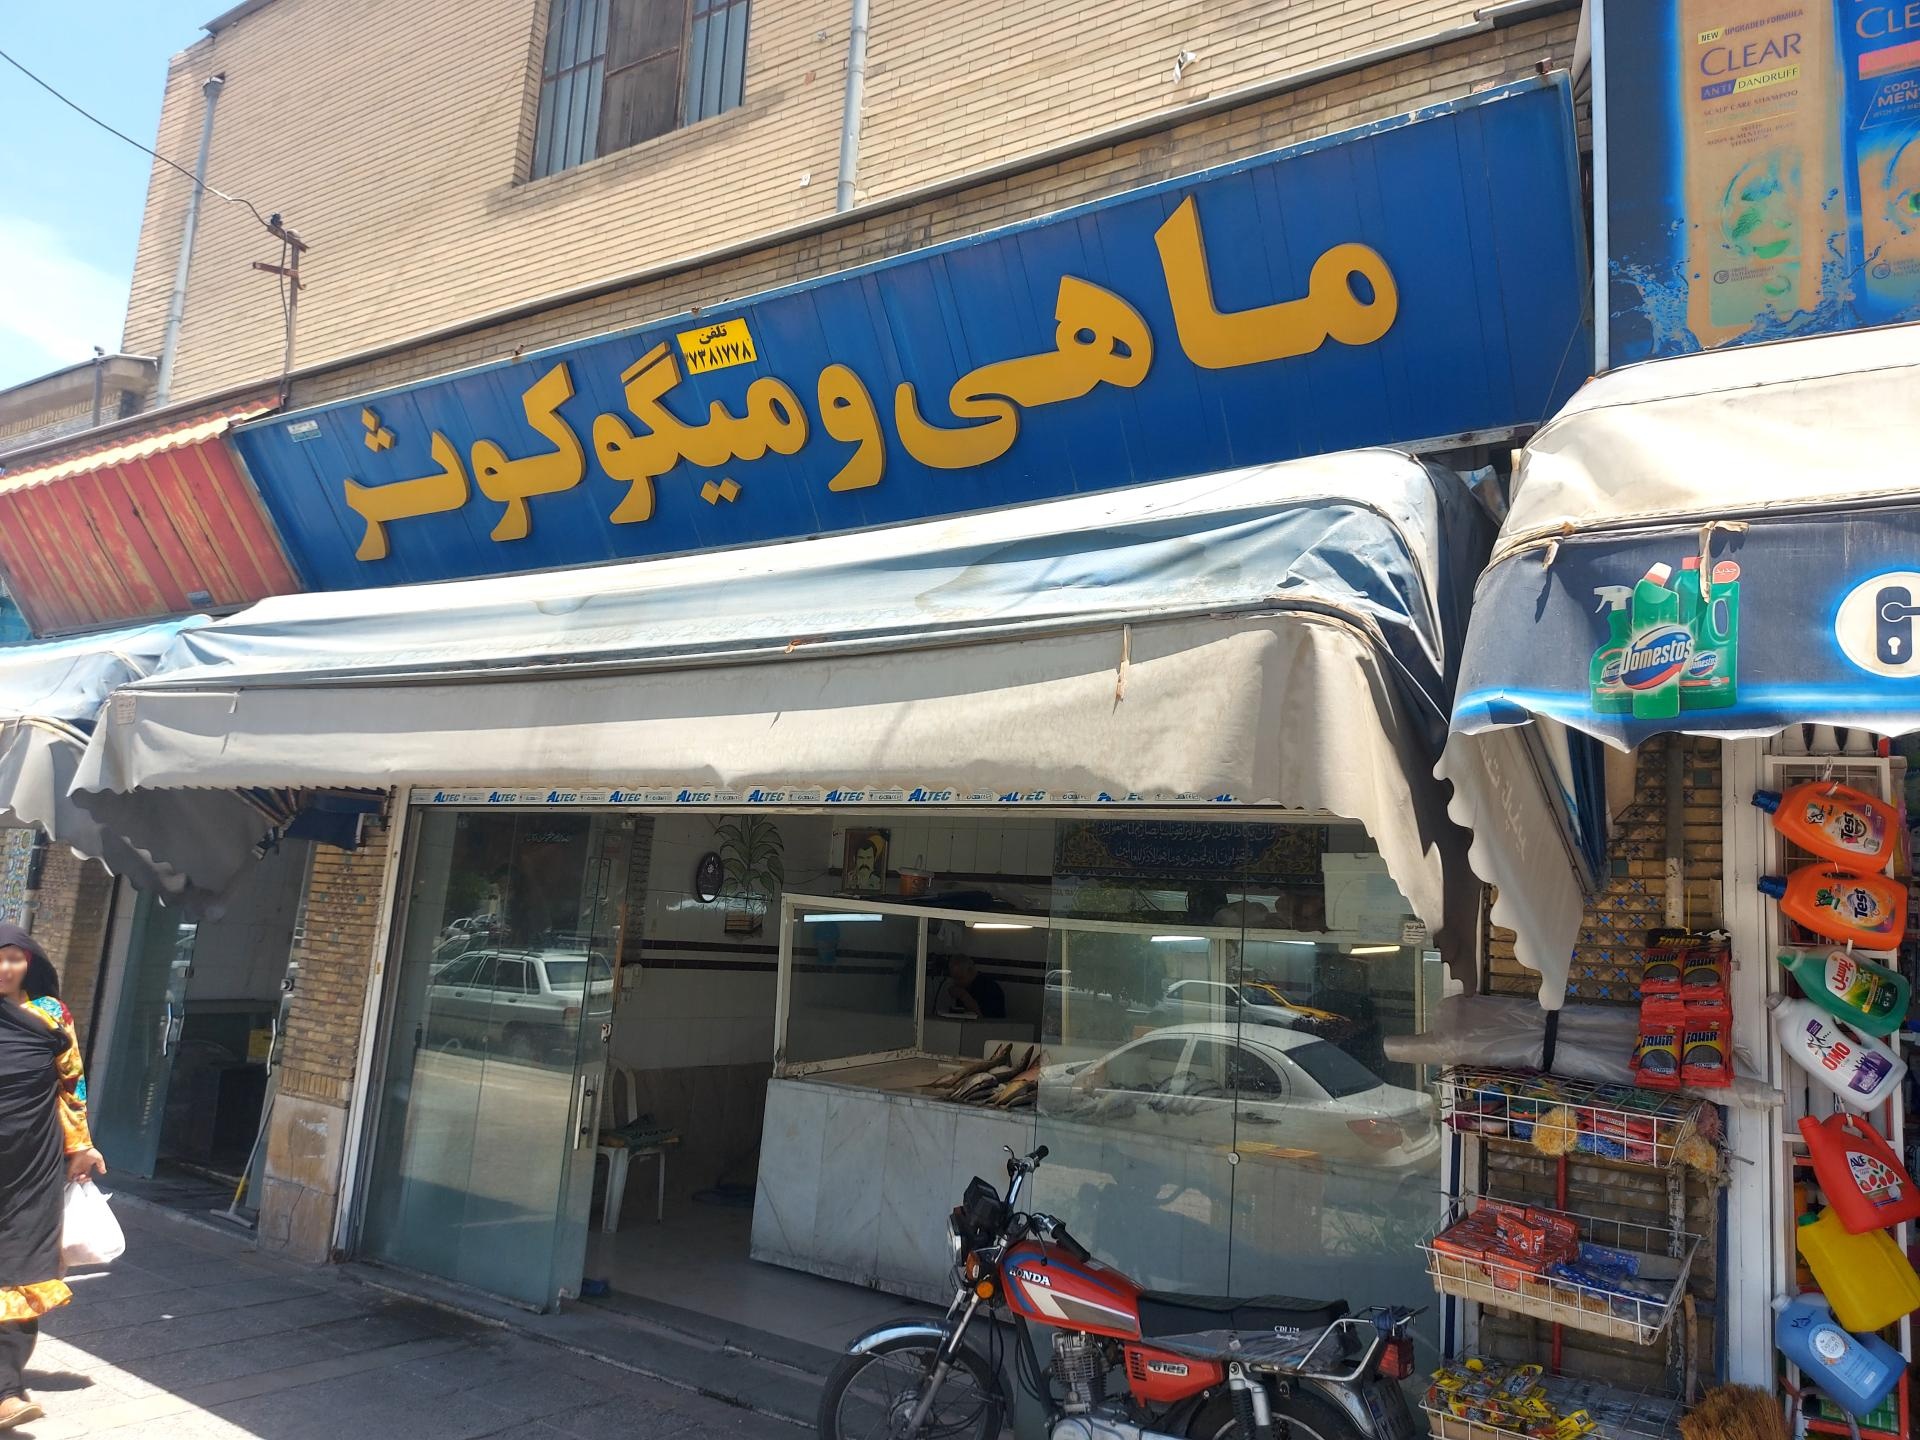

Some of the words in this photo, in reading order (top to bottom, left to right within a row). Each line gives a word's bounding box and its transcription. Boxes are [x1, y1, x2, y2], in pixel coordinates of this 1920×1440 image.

[1701, 31, 1720, 42] NEW
[1724, 19, 1766, 36] UPGRADED
[1700, 32, 1802, 76] CLEAR
[1703, 83, 1733, 98] ANTI
[1738, 67, 1799, 89] DANDRUFF
[1884, 79, 1919, 95] COOL
[699, 324, 728, 345] تلفن
[895, 195, 1399, 470] ماهی
[591, 341, 810, 525] میگو
[817, 363, 887, 492] و
[343, 362, 587, 562] کوثر
[1619, 639, 1695, 675] Domestos
[433, 791, 461, 803] ALTEC
[487, 791, 517, 803] ALTEC
[546, 790, 577, 803] ALTEC
[608, 790, 642, 803] ALTEC
[675, 789, 711, 803] ALTEC
[747, 789, 785, 802] ALTEC
[824, 789, 865, 802] ALTEC
[907, 788, 952, 802] ALTEC
[1841, 811, 1855, 839] Test
[1854, 888, 1868, 918] Test
[1822, 1041, 1851, 1071] OMO
